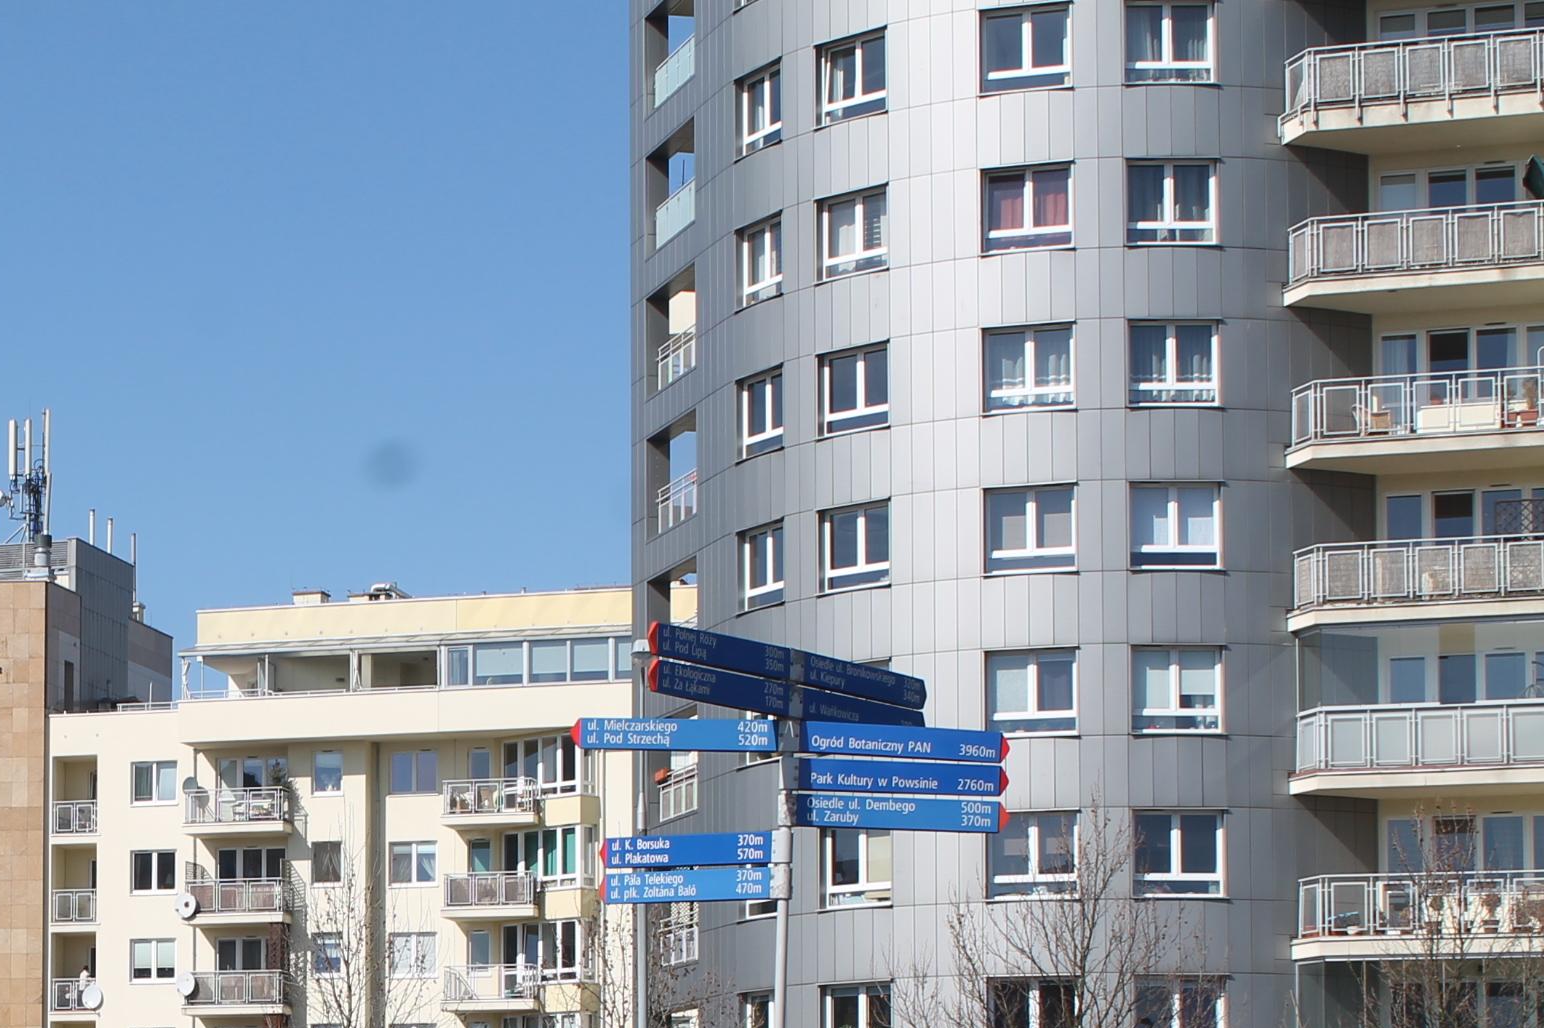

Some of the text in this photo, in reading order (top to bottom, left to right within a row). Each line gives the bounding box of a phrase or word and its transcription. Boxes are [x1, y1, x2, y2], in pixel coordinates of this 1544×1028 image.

[663, 628, 672, 638] ul.
[675, 629, 697, 643] Polnej
[764, 646, 784, 658] 300m
[662, 639, 672, 650] ul.
[675, 641, 689, 654] Pod
[765, 658, 784, 672] 350m
[810, 655, 834, 672] Osiedle
[663, 663, 784, 696] ul. Ekologiczna 270m
[809, 671, 817, 681] ul.
[662, 677, 672, 688] ul.
[674, 678, 683, 690] Za
[765, 696, 784, 709] 170m
[808, 703, 816, 713] ul.
[587, 720, 768, 734] ul. Mielczarskiego 420m
[587, 732, 768, 747] ul. Pod Strzechą 520m
[811, 734, 996, 759] Ogród Botaniczny PAN 3960m
[810, 772, 995, 792] Park Kultury w Powsinie 2760m
[807, 797, 992, 815] Osiedle ul. Dembego 500m
[807, 810, 991, 827] ul. Zaruby 370m
[611, 834, 764, 851] ul. K. Borsuka 370m
[611, 848, 764, 865] ul. Plakatowa 570m
[610, 876, 621, 887] ul.
[644, 873, 684, 888] Telekiego
[736, 869, 762, 881] 370m
[610, 888, 621, 899] ul.
[643, 885, 675, 898] Zoltána
[677, 884, 697, 897] Baló
[735, 882, 762, 894] 470m
